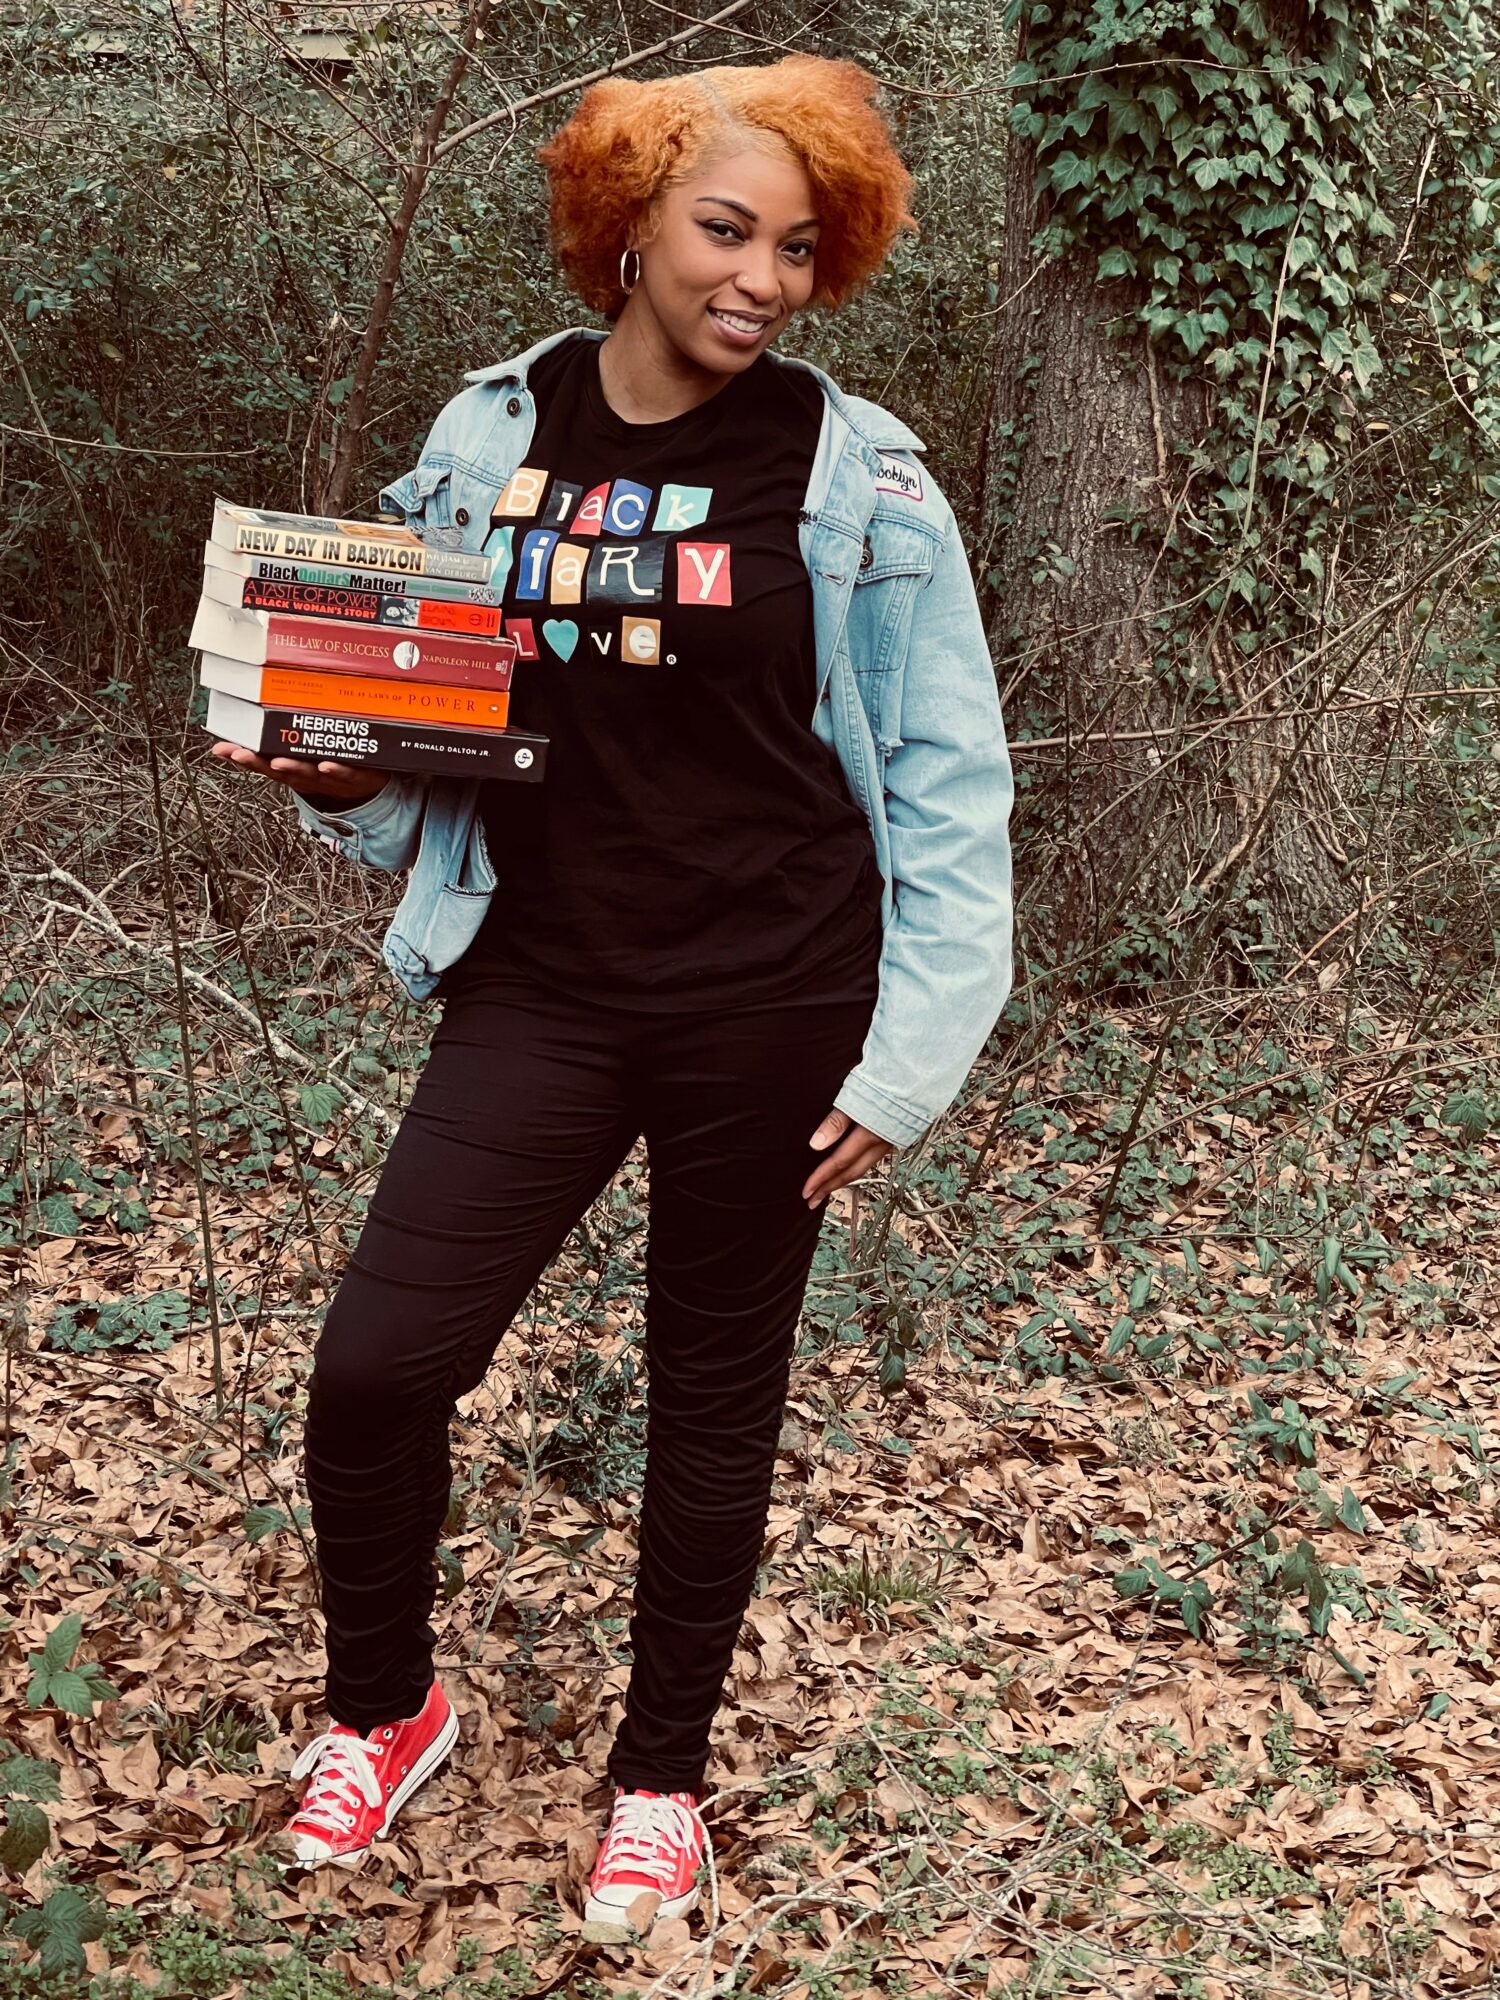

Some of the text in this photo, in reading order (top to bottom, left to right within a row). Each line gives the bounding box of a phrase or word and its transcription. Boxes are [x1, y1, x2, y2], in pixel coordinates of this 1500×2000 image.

[877, 465, 918, 491] ooklyn
[240, 529, 422, 571] NEW DAY IN BABYLON
[425, 566, 478, 580] VAN DEBURG
[245, 580, 378, 609] A TASTE OF POWER
[243, 596, 377, 619] A BLACK WOMAN'S STORY
[272, 633, 390, 658] THE LAW OF SUCCESS
[422, 654, 491, 670] NAPOLEON HILL
[338, 689, 354, 697] THE
[408, 694, 475, 712] POWER
[292, 713, 370, 737] HEBREWS
[279, 728, 379, 754] TO NEGROES
[289, 746, 307, 754] WAKE
[317, 749, 336, 757] BLACK
[413, 742, 445, 752] RONALD
[447, 746, 477, 755] DALTON
